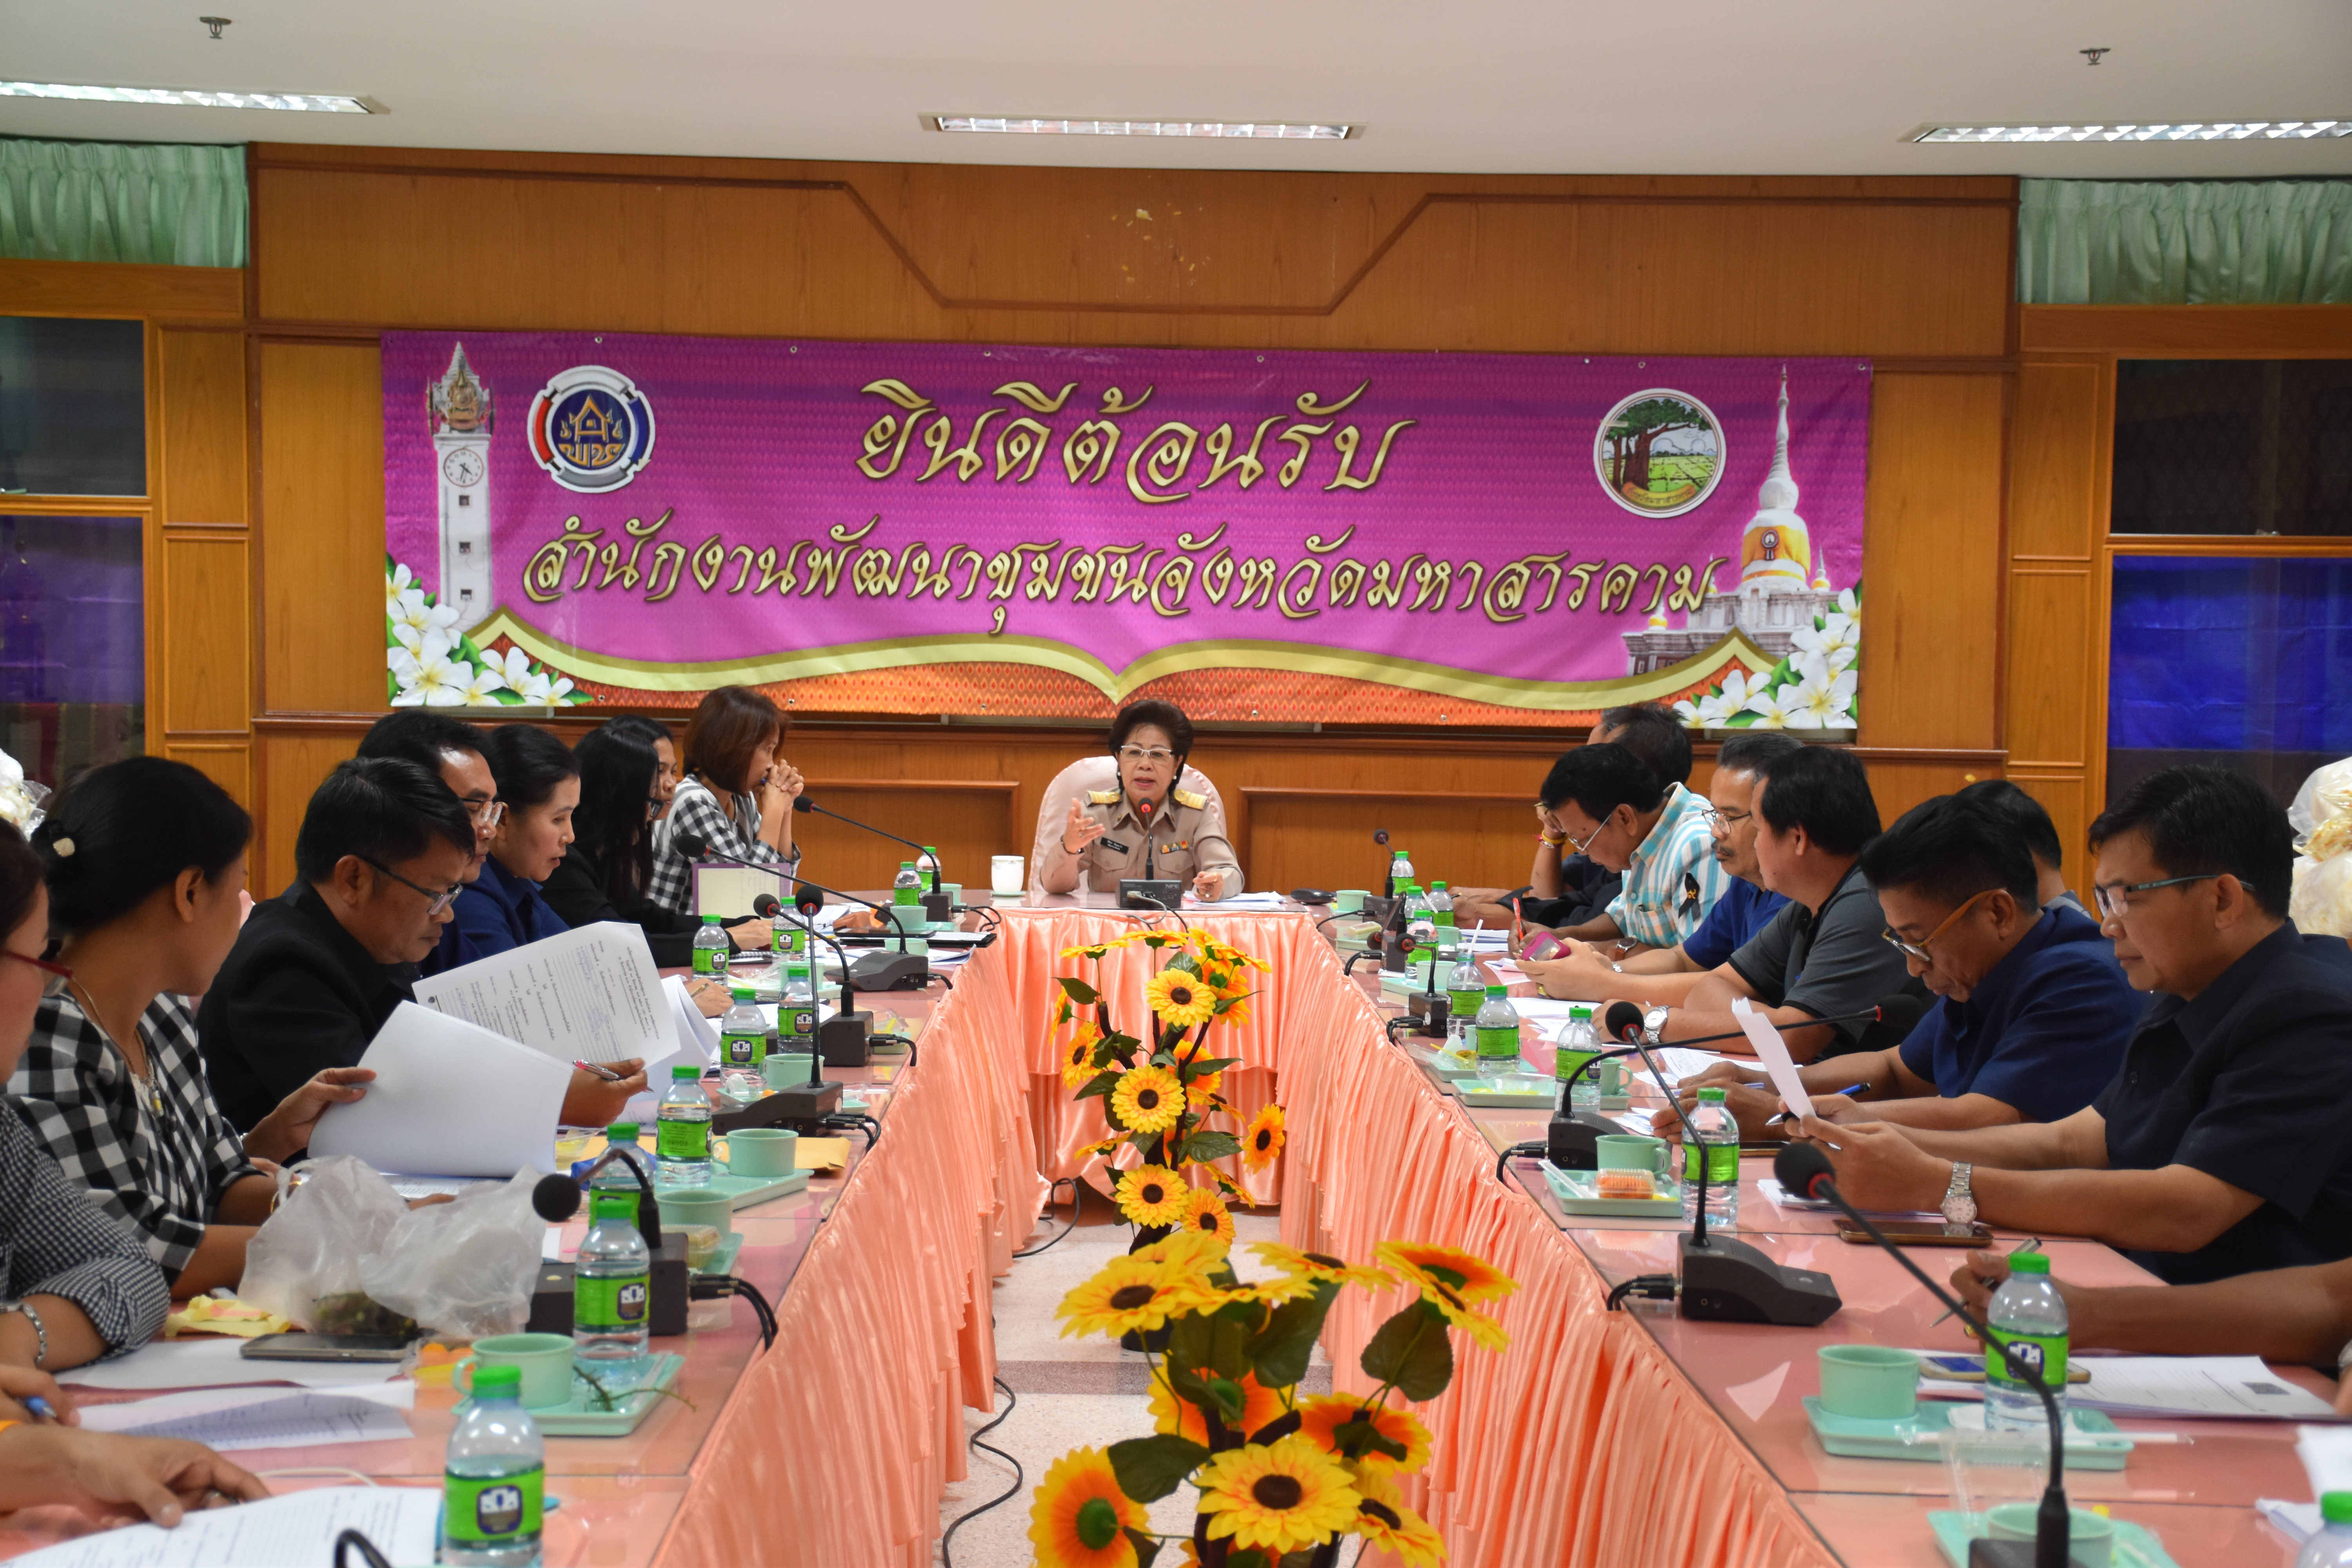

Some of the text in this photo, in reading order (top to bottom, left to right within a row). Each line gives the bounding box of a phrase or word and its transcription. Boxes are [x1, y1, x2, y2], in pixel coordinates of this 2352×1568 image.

[856, 378, 1417, 503] ยินดีต้อนรับ
[523, 507, 1728, 637] สำนักงานพัฒนาชุมชนจังหวัดมหาสารคาม
